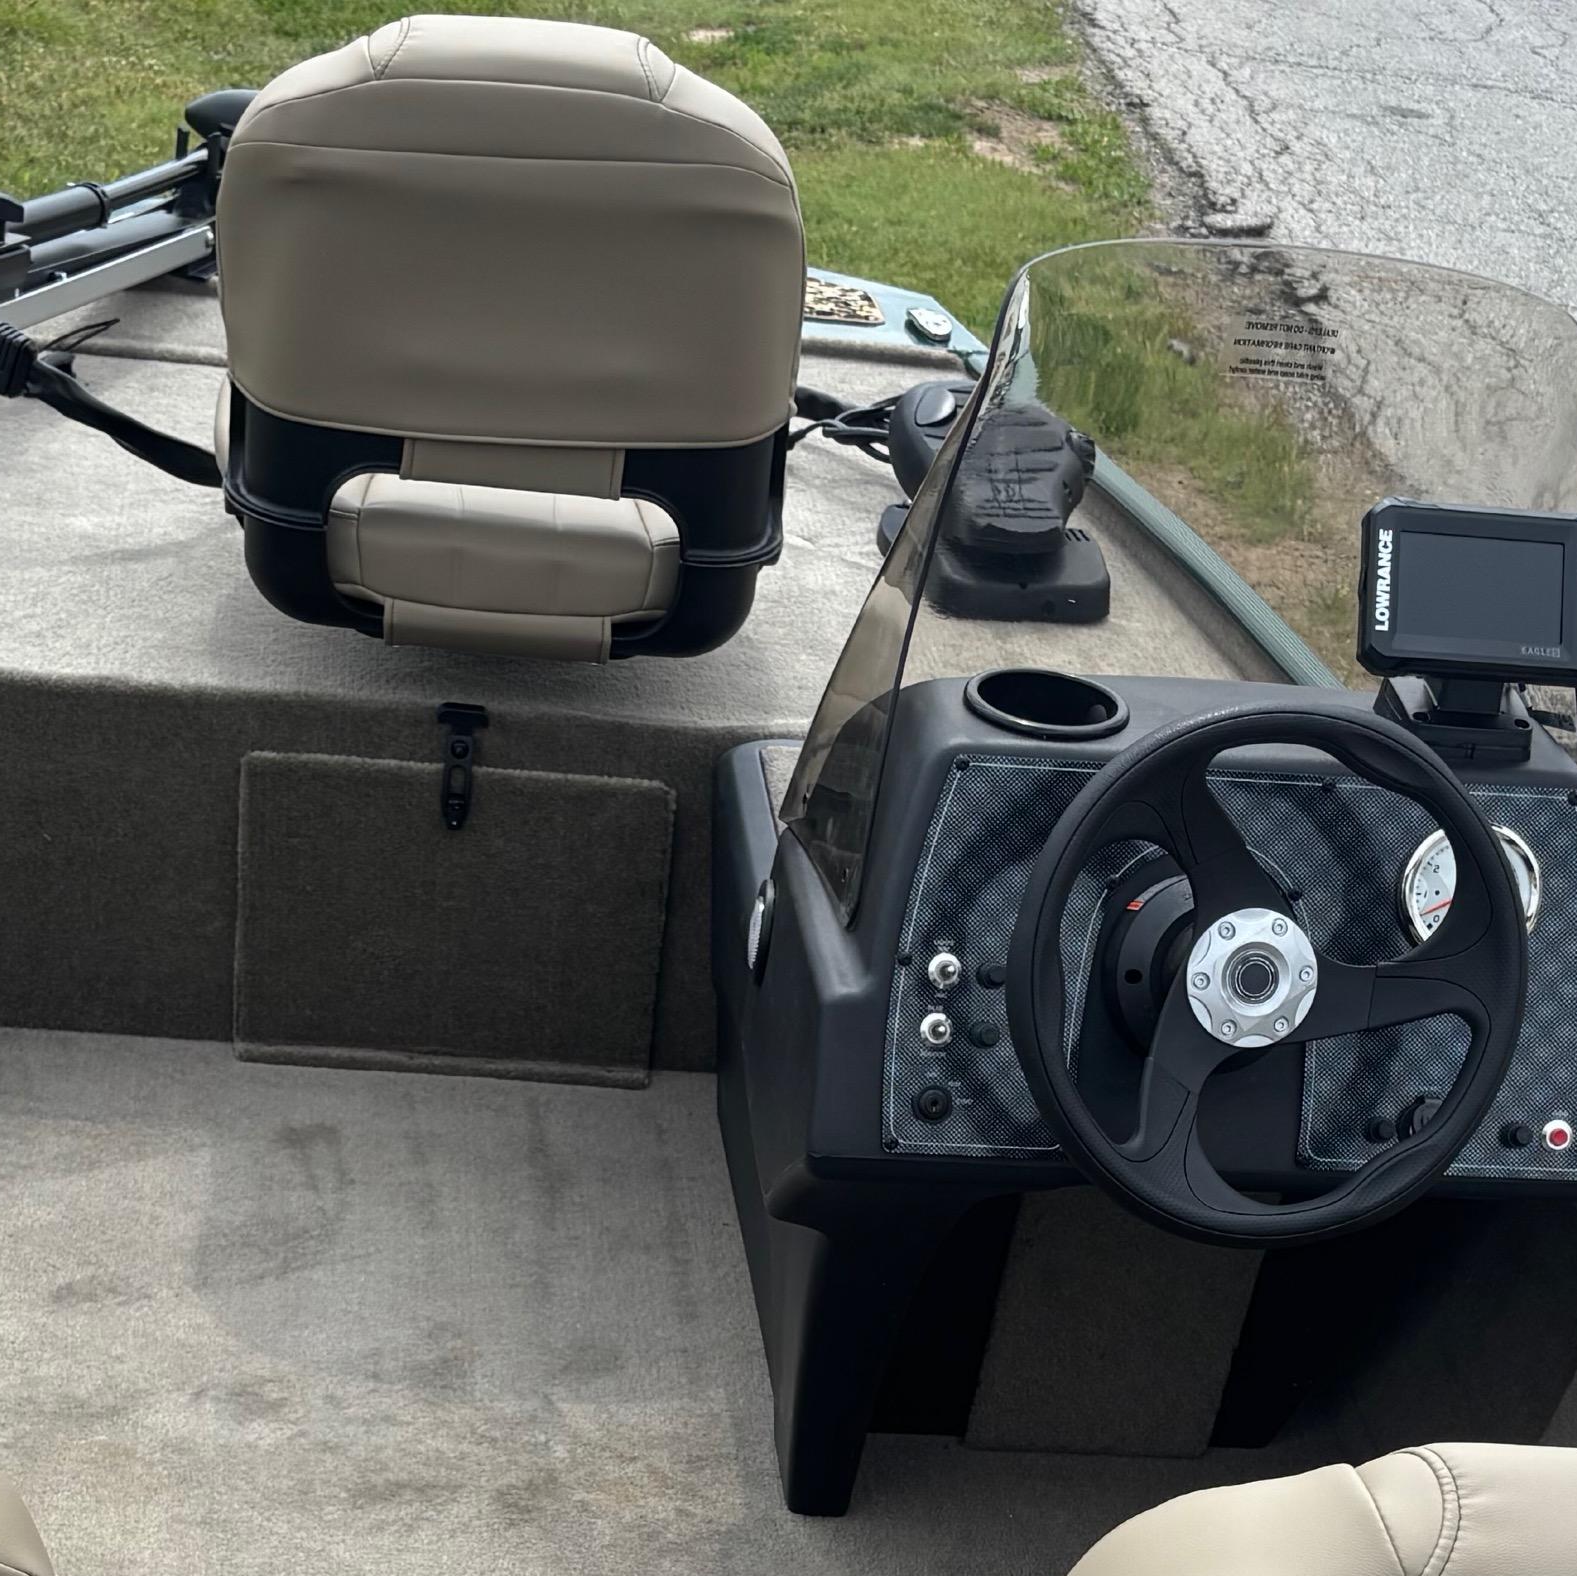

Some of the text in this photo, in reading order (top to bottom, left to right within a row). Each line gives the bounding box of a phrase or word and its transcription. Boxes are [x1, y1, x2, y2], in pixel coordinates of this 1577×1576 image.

[1375, 528, 1393, 632] LOWRANCE
[1432, 865, 1440, 874] 2
[1432, 914, 1440, 923] 0
